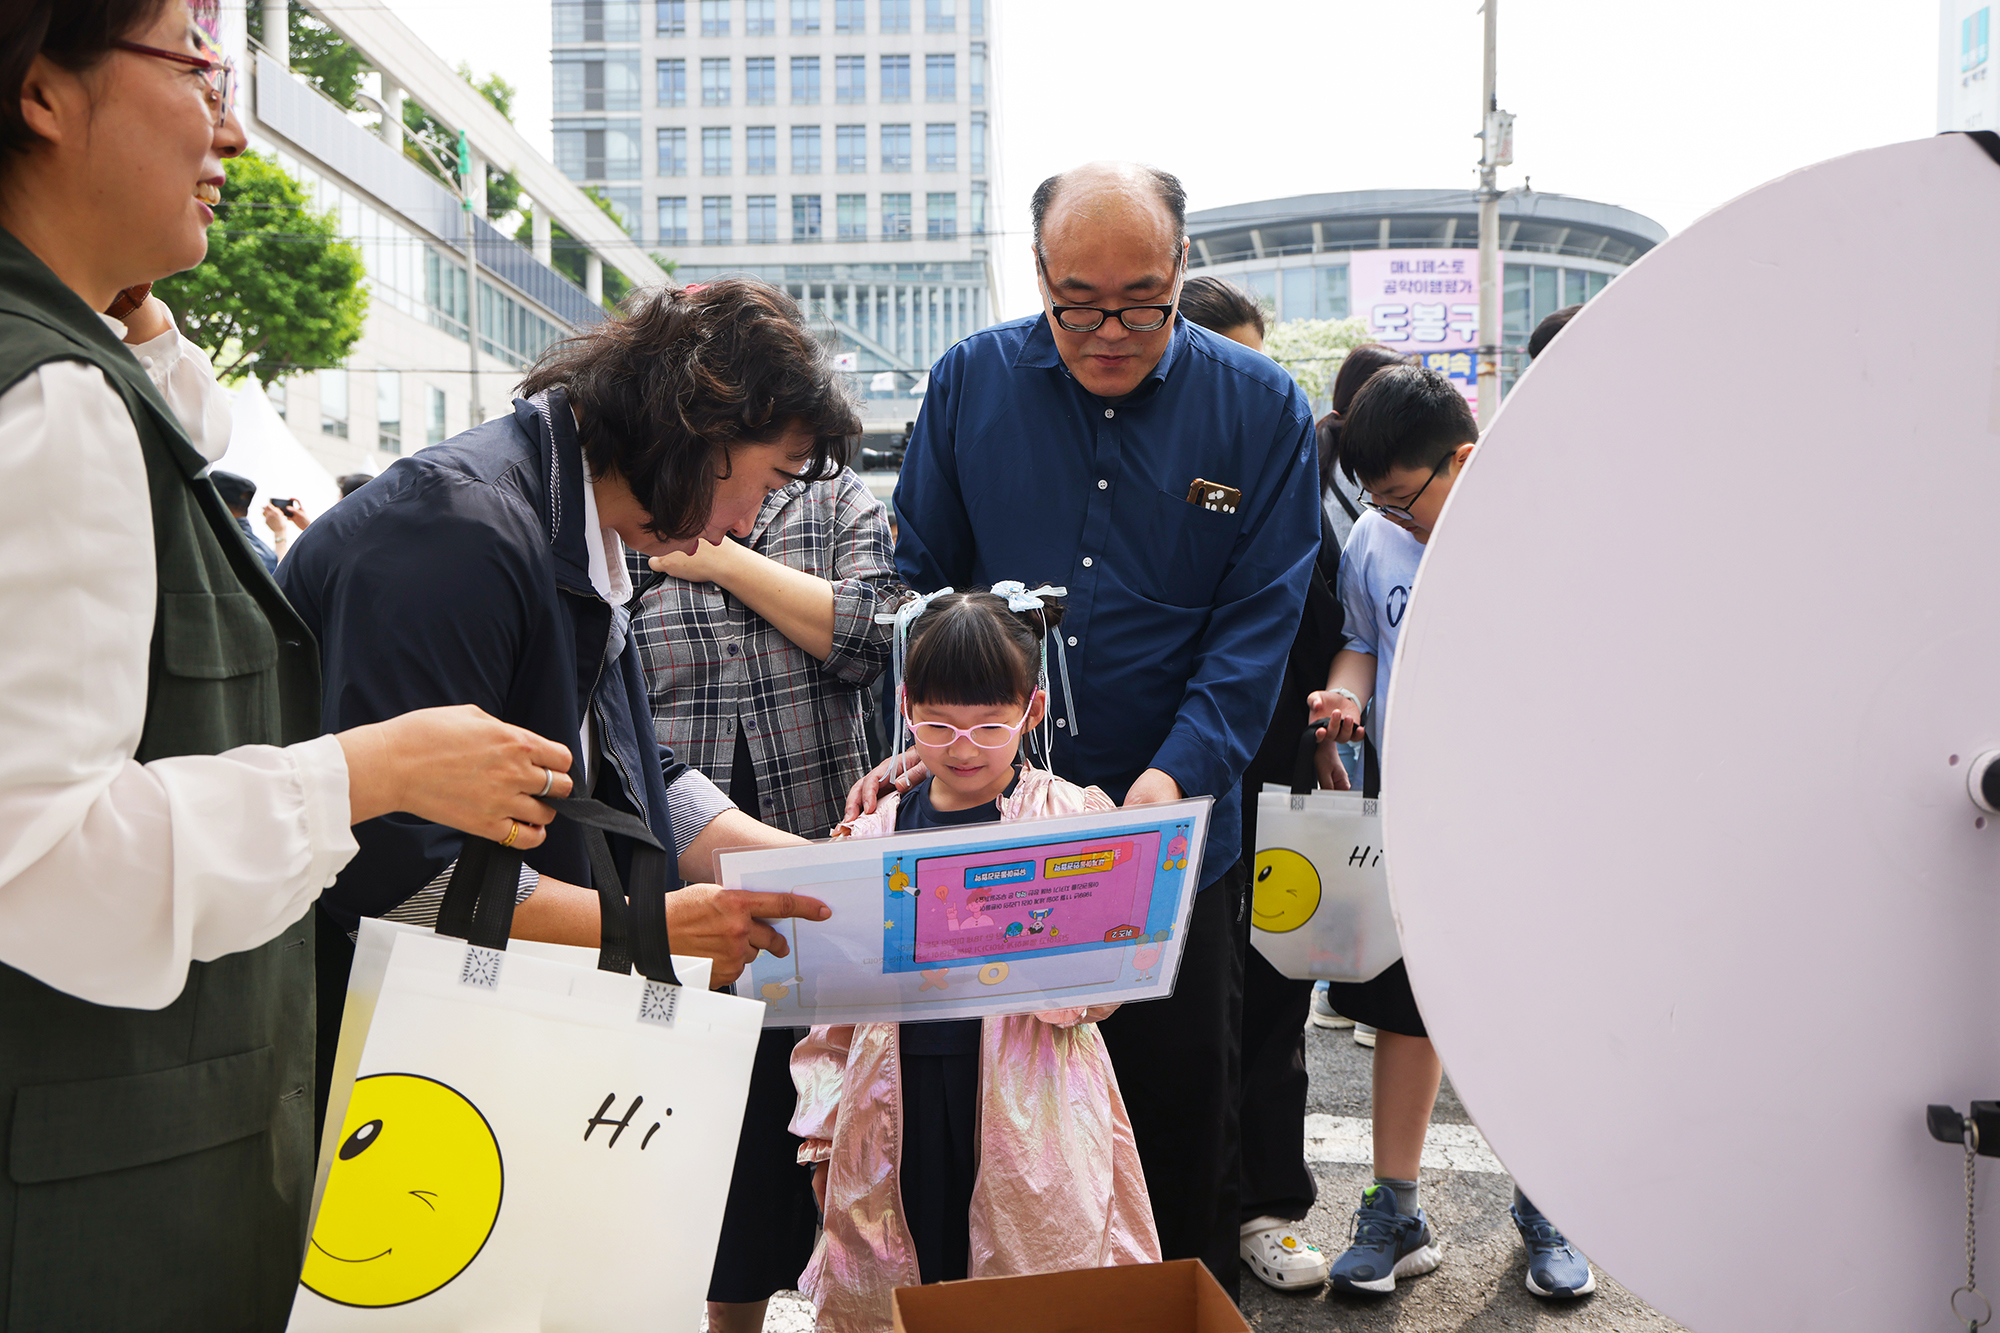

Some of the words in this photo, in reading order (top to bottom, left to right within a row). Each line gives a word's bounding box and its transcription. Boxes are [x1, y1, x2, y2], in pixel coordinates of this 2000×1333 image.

[1390, 260, 1464, 274] 매니페스토
[1372, 302, 1480, 343] 도봉구
[1427, 353, 1472, 377] 연속
[1348, 845, 1383, 868] Hi
[974, 868, 1027, 881] 유엔아동권리협약
[1070, 881, 1099, 890] 아동권리를
[1014, 890, 1027, 898] 약속
[979, 903, 1002, 911] 어른들이
[1002, 900, 1020, 908] 나라의
[1118, 928, 1133, 937] 퀴즈
[584, 1092, 673, 1151] Hi
